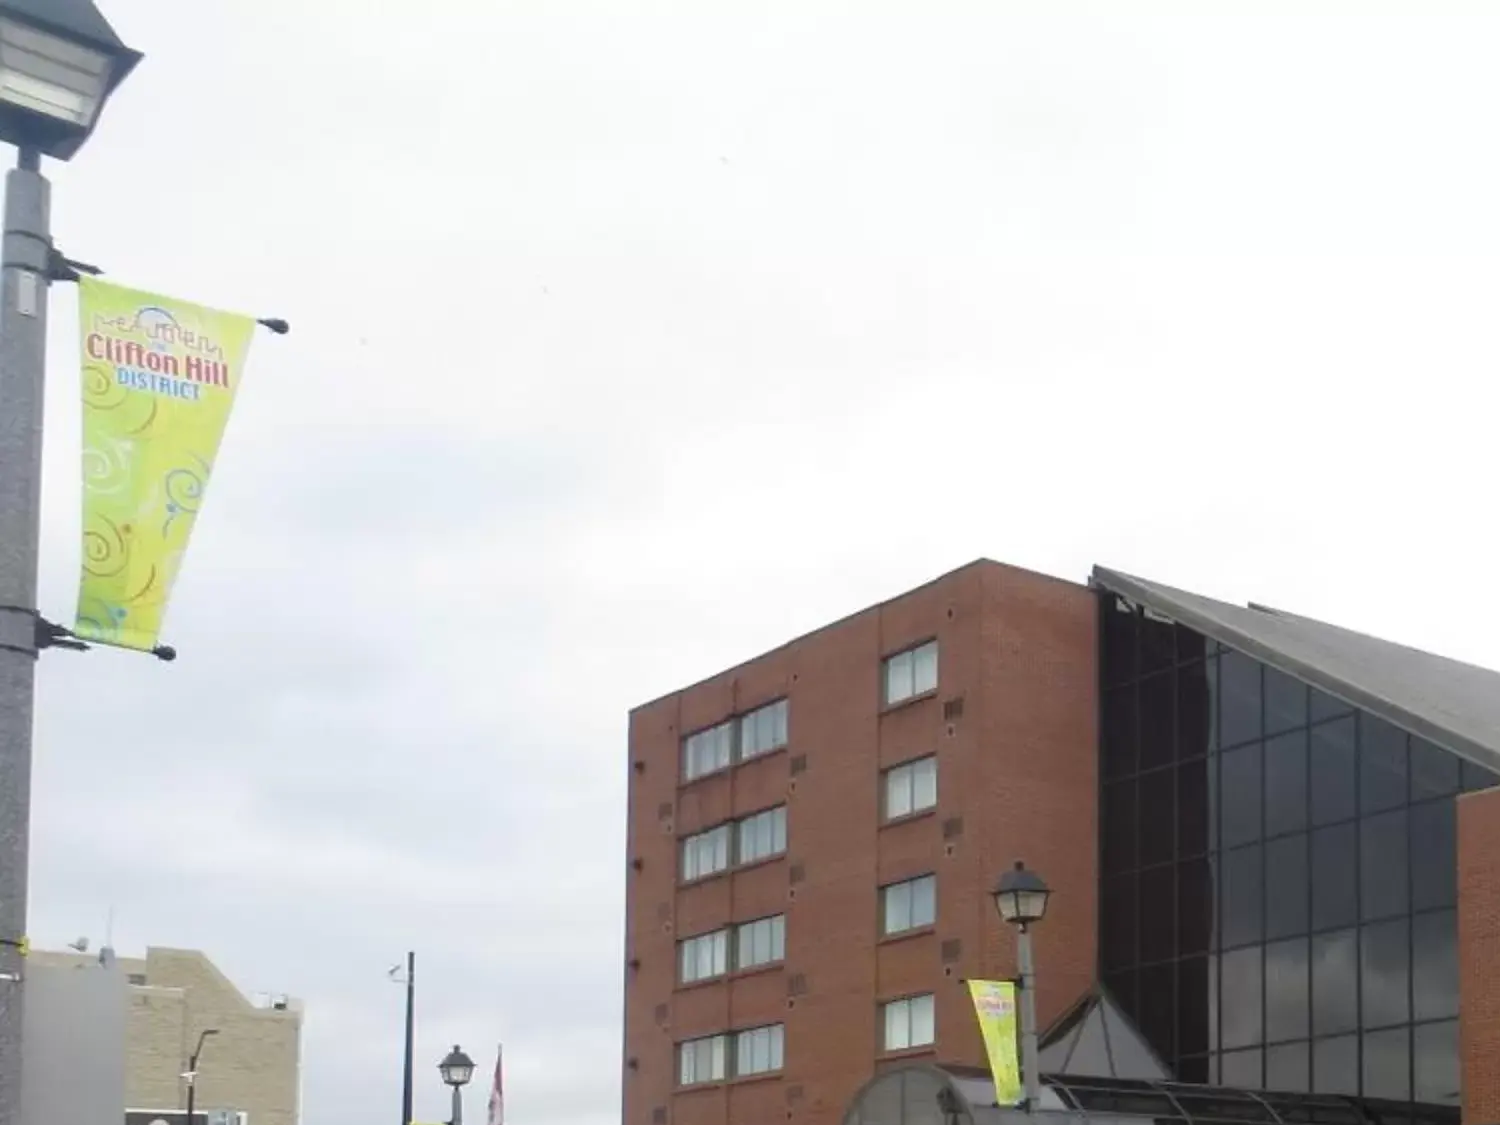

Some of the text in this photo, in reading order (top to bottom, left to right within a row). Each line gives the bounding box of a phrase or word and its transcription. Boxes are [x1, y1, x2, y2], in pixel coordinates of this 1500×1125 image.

[86, 333, 230, 389] Clifton Hill
[117, 367, 200, 400] DISTRICT
